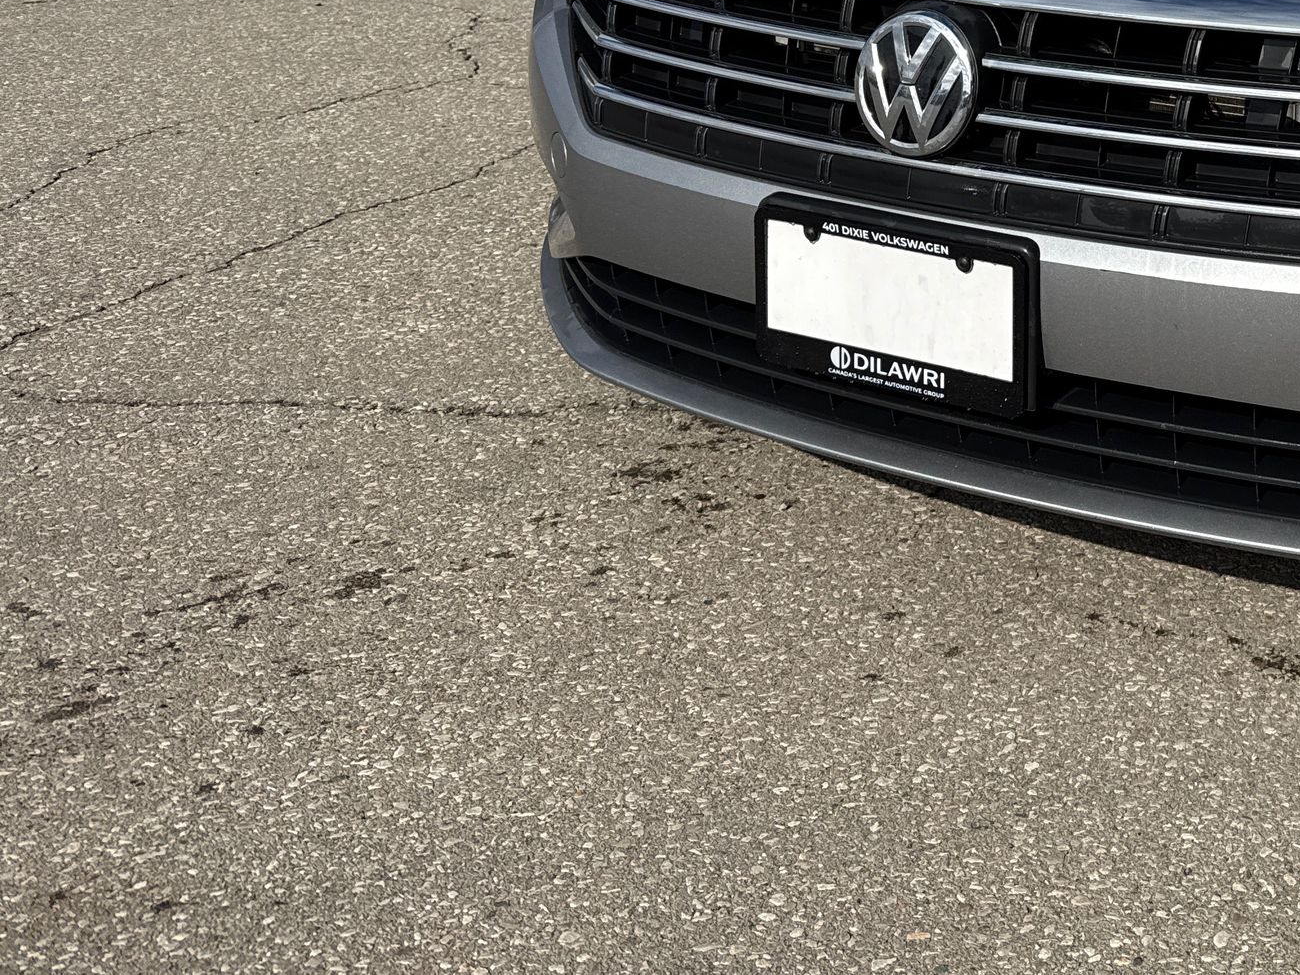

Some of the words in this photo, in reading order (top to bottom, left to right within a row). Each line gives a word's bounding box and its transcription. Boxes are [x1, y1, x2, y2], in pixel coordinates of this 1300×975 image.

[859, 15, 970, 155] VW
[822, 221, 840, 234] 401
[841, 225, 870, 240] DIXIE
[871, 231, 949, 255] VOLKSWAGEN
[827, 367, 857, 379] CANADA'S
[857, 374, 884, 385] LARGEST
[884, 380, 922, 394] AUTOMOTIVE
[923, 389, 945, 399] GROUP
[853, 352, 945, 389] DILAWRI
